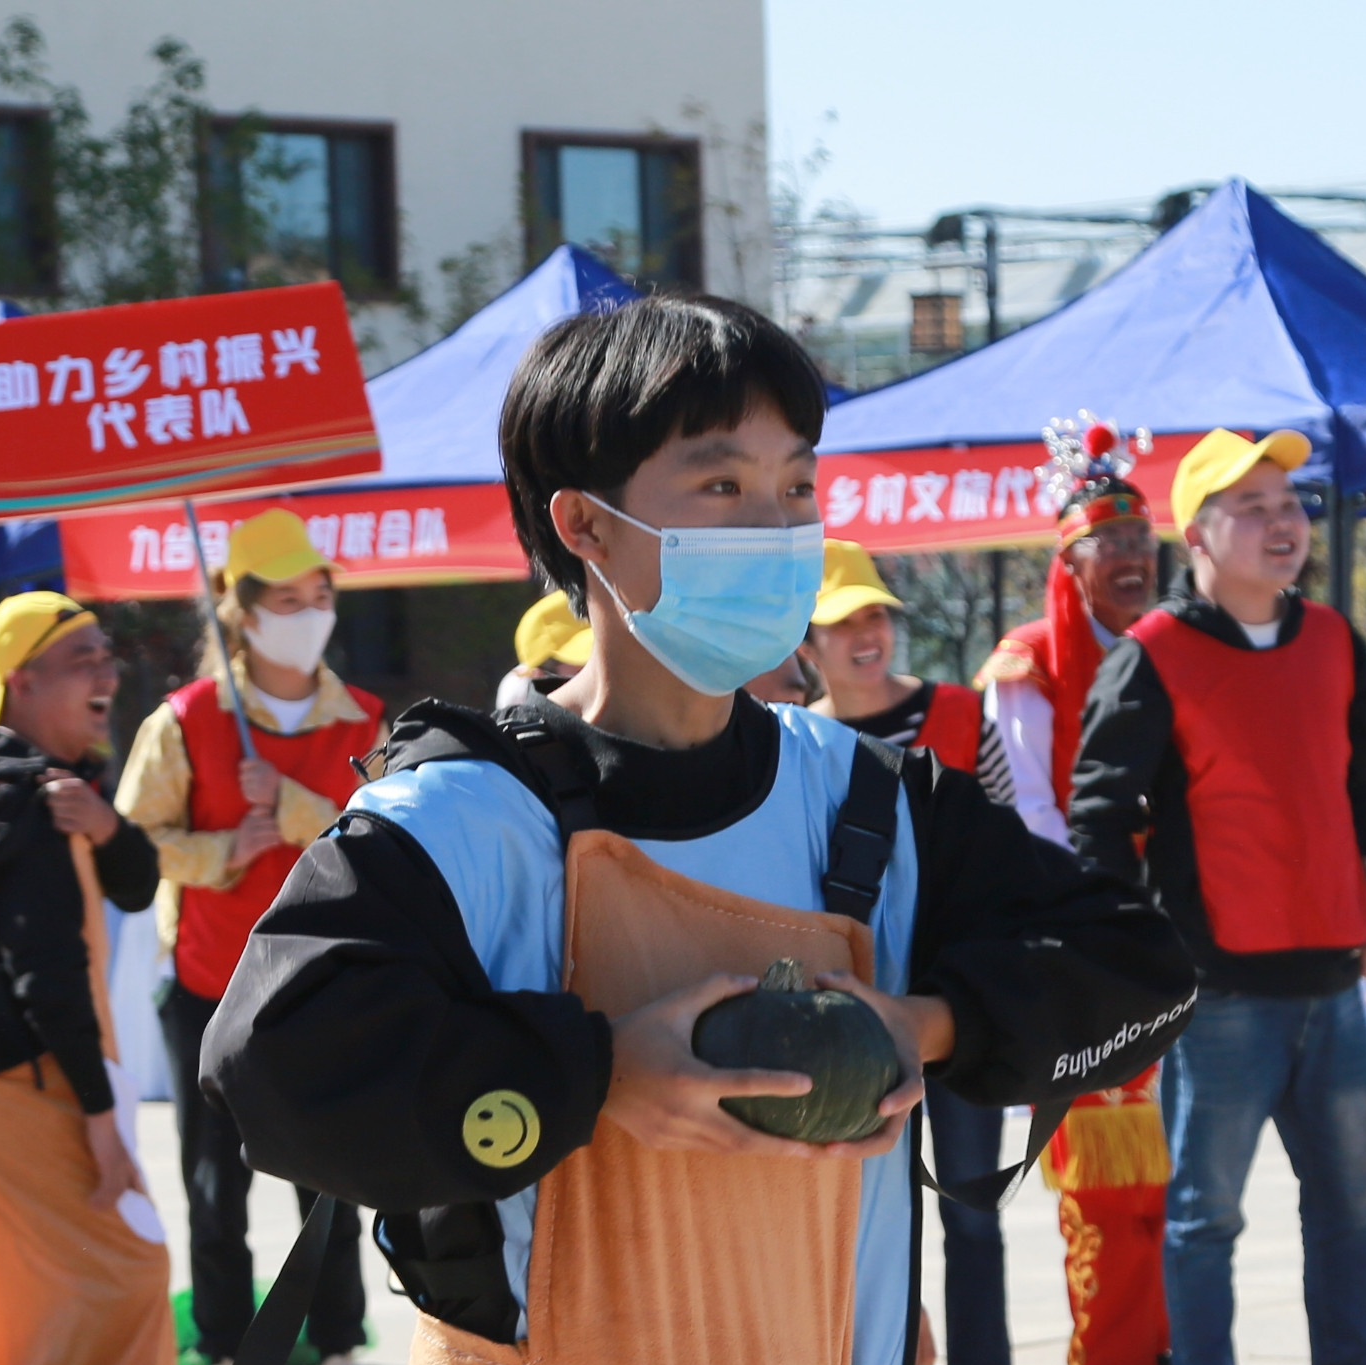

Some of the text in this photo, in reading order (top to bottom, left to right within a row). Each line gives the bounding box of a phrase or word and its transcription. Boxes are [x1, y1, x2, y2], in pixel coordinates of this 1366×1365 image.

[87, 387, 251, 452] 代表队
[1051, 984, 1199, 1081] pod-opening
